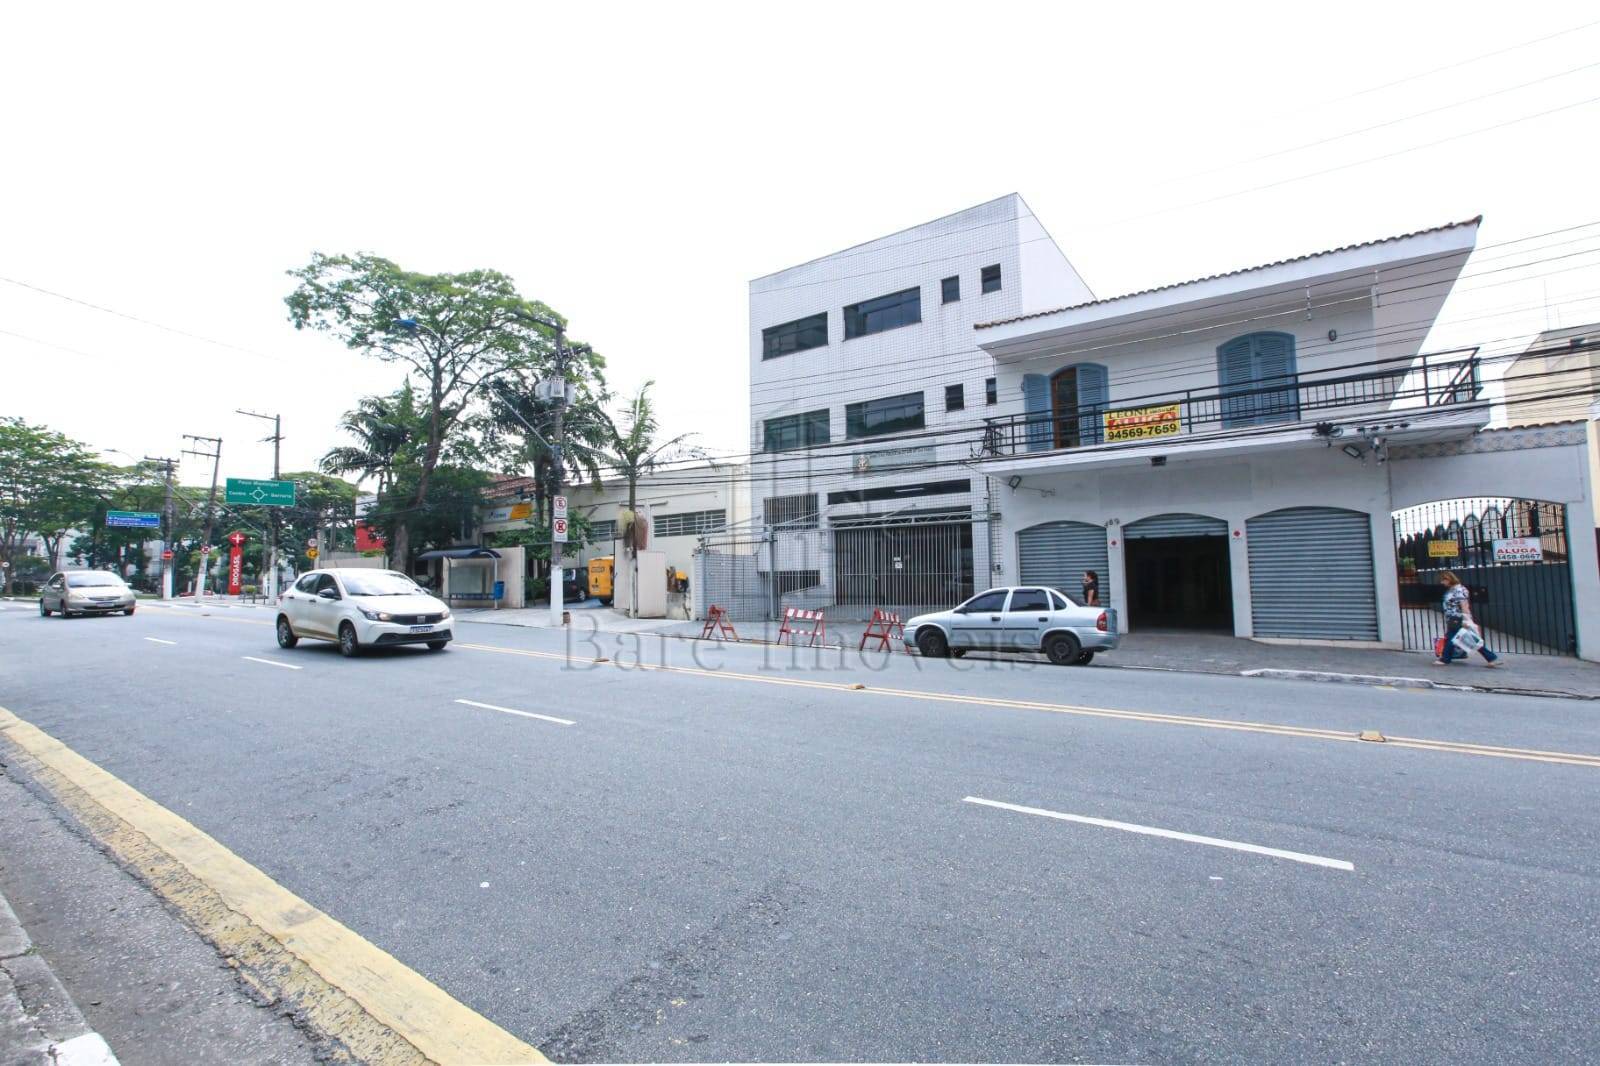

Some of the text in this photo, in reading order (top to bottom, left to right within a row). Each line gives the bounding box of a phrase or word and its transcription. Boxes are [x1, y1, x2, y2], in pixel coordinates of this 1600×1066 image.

[1108, 423, 1177, 440] 94569-7659
[1497, 547, 1538, 555] ALUGA
[232, 555, 241, 586] DROGASIL
